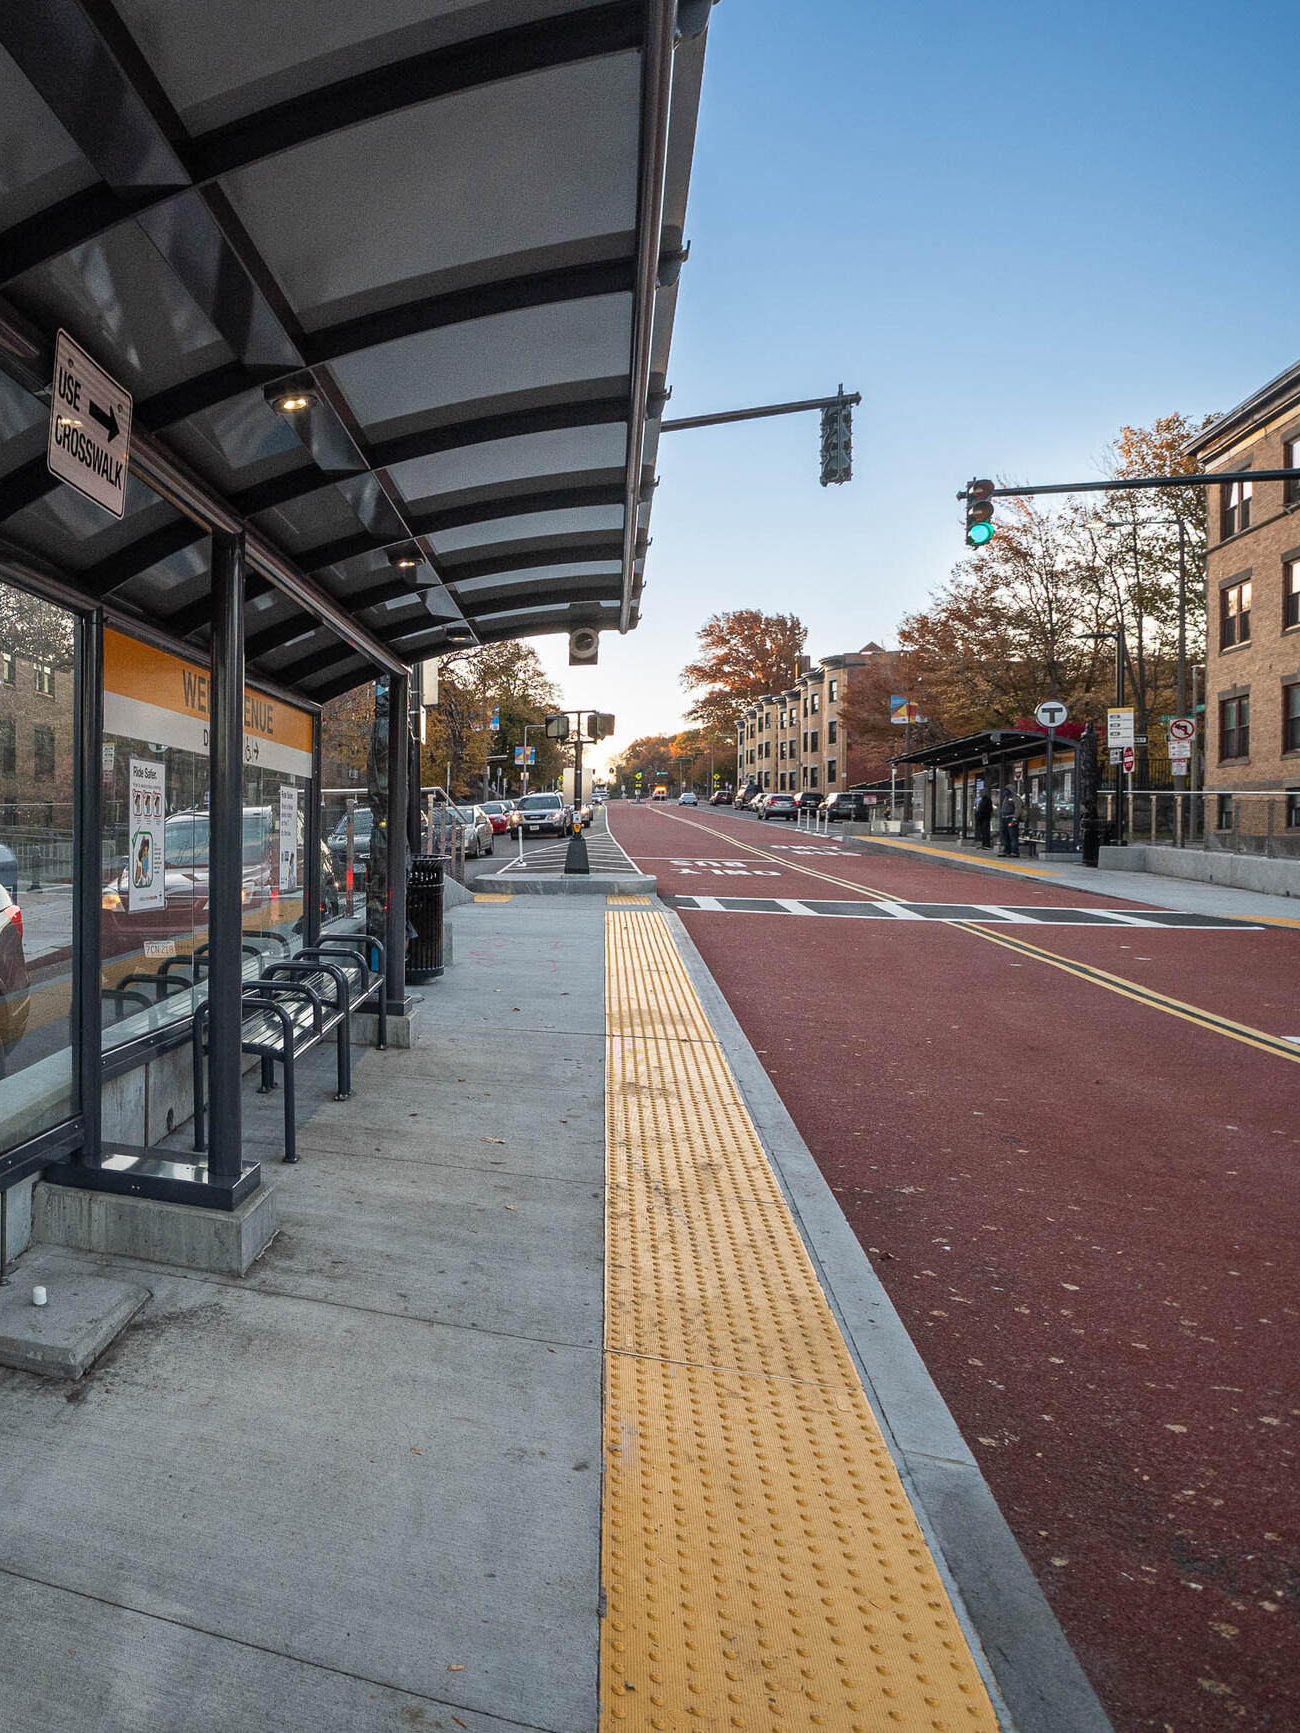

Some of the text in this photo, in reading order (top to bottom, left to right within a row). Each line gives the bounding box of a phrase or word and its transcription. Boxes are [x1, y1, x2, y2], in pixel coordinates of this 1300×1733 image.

[58, 366, 82, 412] USE
[55, 414, 123, 490] CROSSWALK
[243, 695, 274, 735] ENUE
